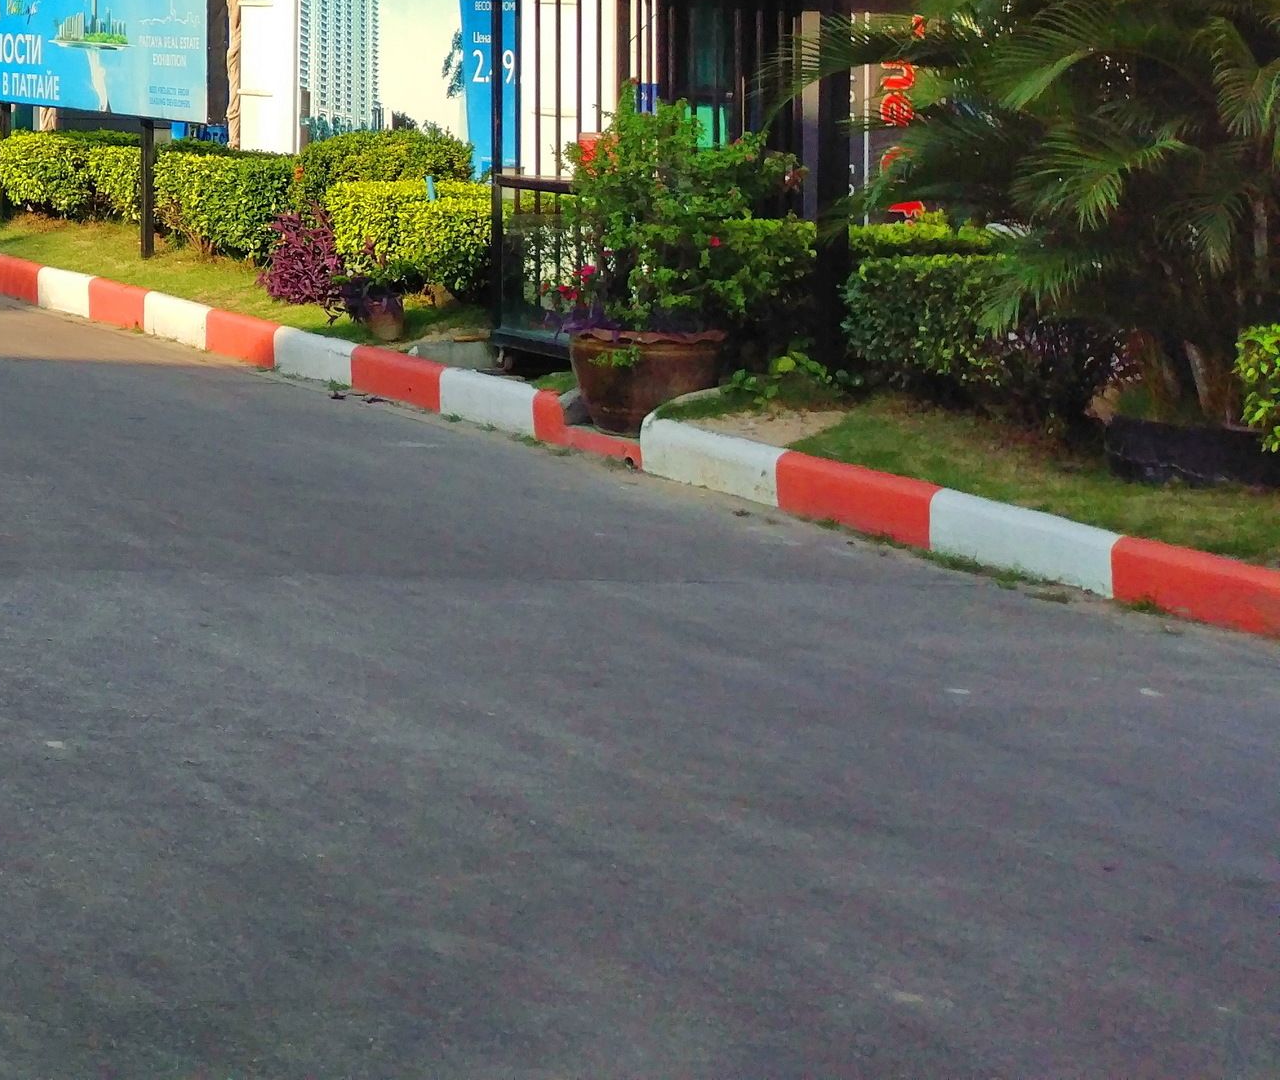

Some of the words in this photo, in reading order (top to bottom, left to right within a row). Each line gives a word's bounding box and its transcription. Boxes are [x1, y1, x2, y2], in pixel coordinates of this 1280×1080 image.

[179, 36, 200, 50] ESTATE
[473, 31, 492, 44] Цена
[2, 71, 10, 96] В
[11, 69, 60, 101] ПАТТАЙЕ
